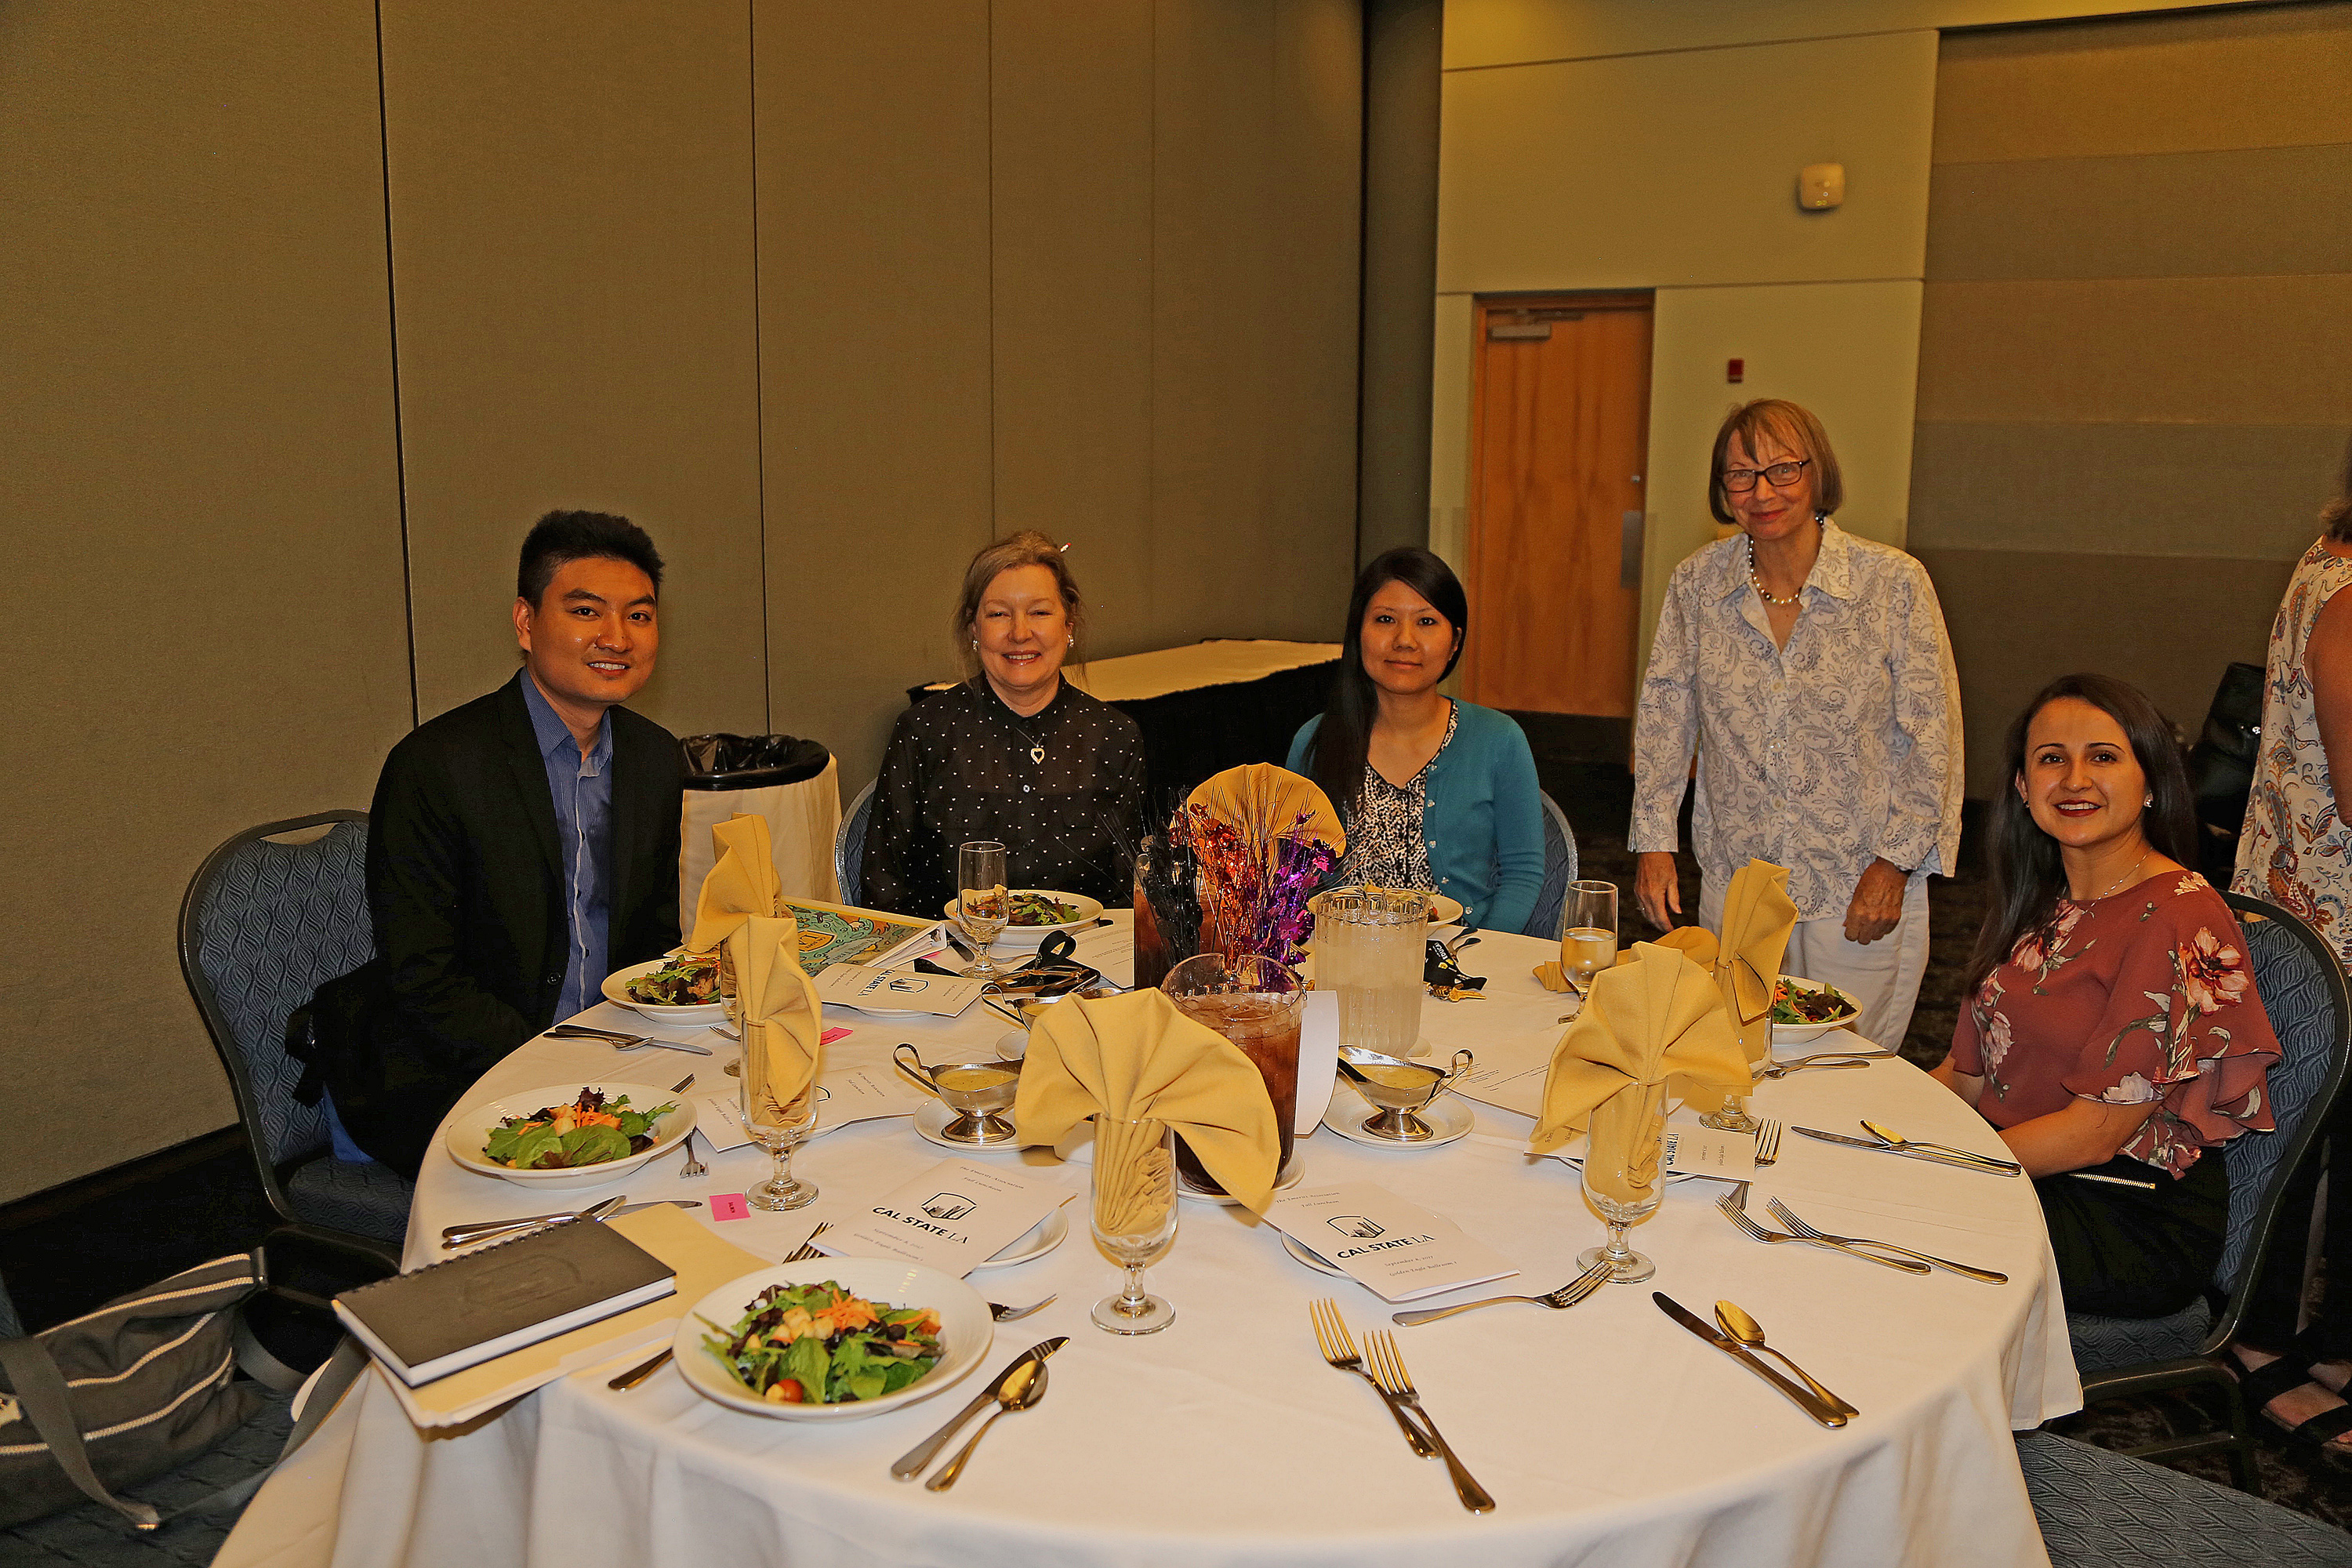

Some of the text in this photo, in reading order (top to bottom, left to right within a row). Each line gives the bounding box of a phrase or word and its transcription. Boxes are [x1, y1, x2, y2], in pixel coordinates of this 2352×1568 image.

[1435, 942, 1448, 960] EDUCA
[866, 975, 886, 989] STATE
[872, 1207, 968, 1244] CAL STATE LA
[1337, 1234, 1436, 1258] CAL STATE LA
